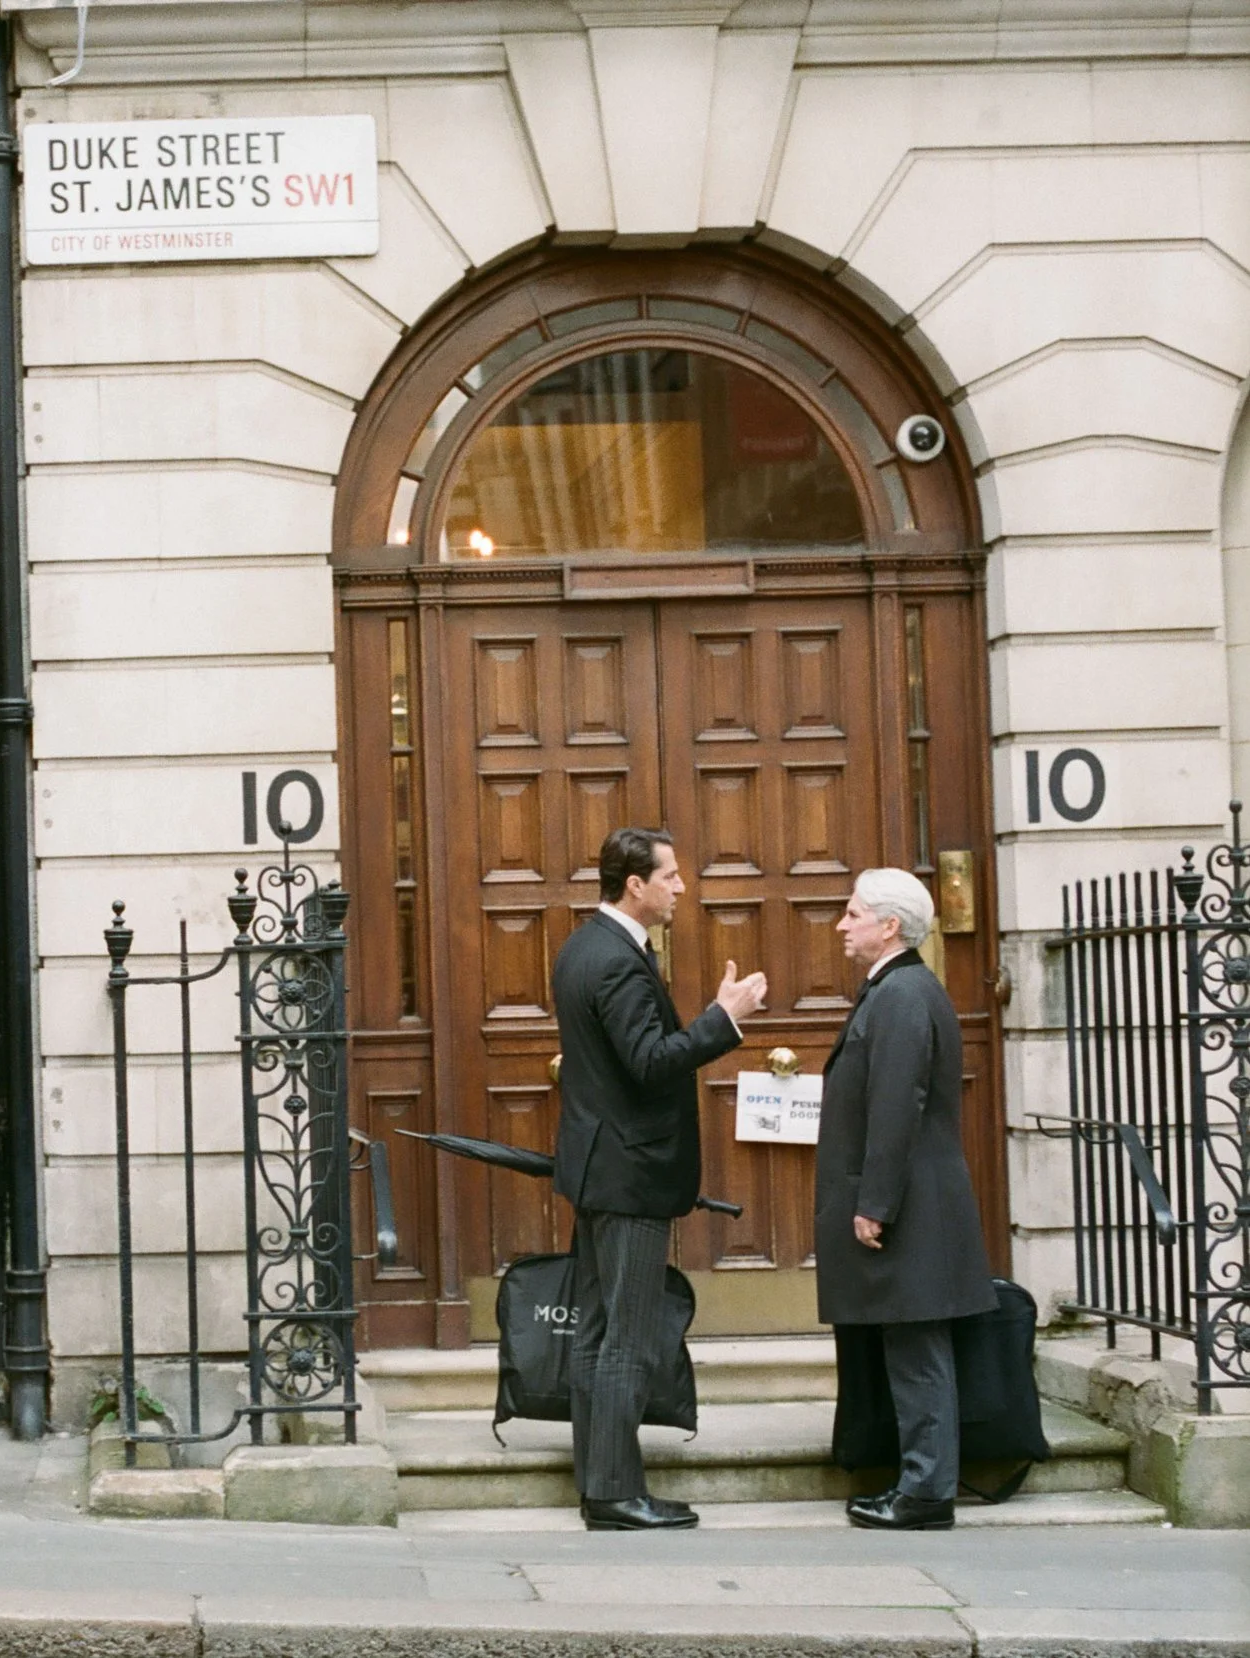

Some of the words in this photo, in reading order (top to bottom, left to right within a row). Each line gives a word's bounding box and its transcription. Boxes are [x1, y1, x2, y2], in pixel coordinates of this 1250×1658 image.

[49, 136, 139, 171] DUKE
[157, 132, 285, 167] STREET
[50, 181, 99, 213] ST.
[116, 175, 270, 211] JAMES'S
[284, 172, 354, 207] SW1
[51, 236, 86, 252] CITY
[93, 235, 112, 251] OF
[117, 231, 234, 249] WESTMINSTER
[1025, 748, 1106, 824] 10
[242, 769, 324, 845] 10
[746, 1095, 782, 1105] OPEN
